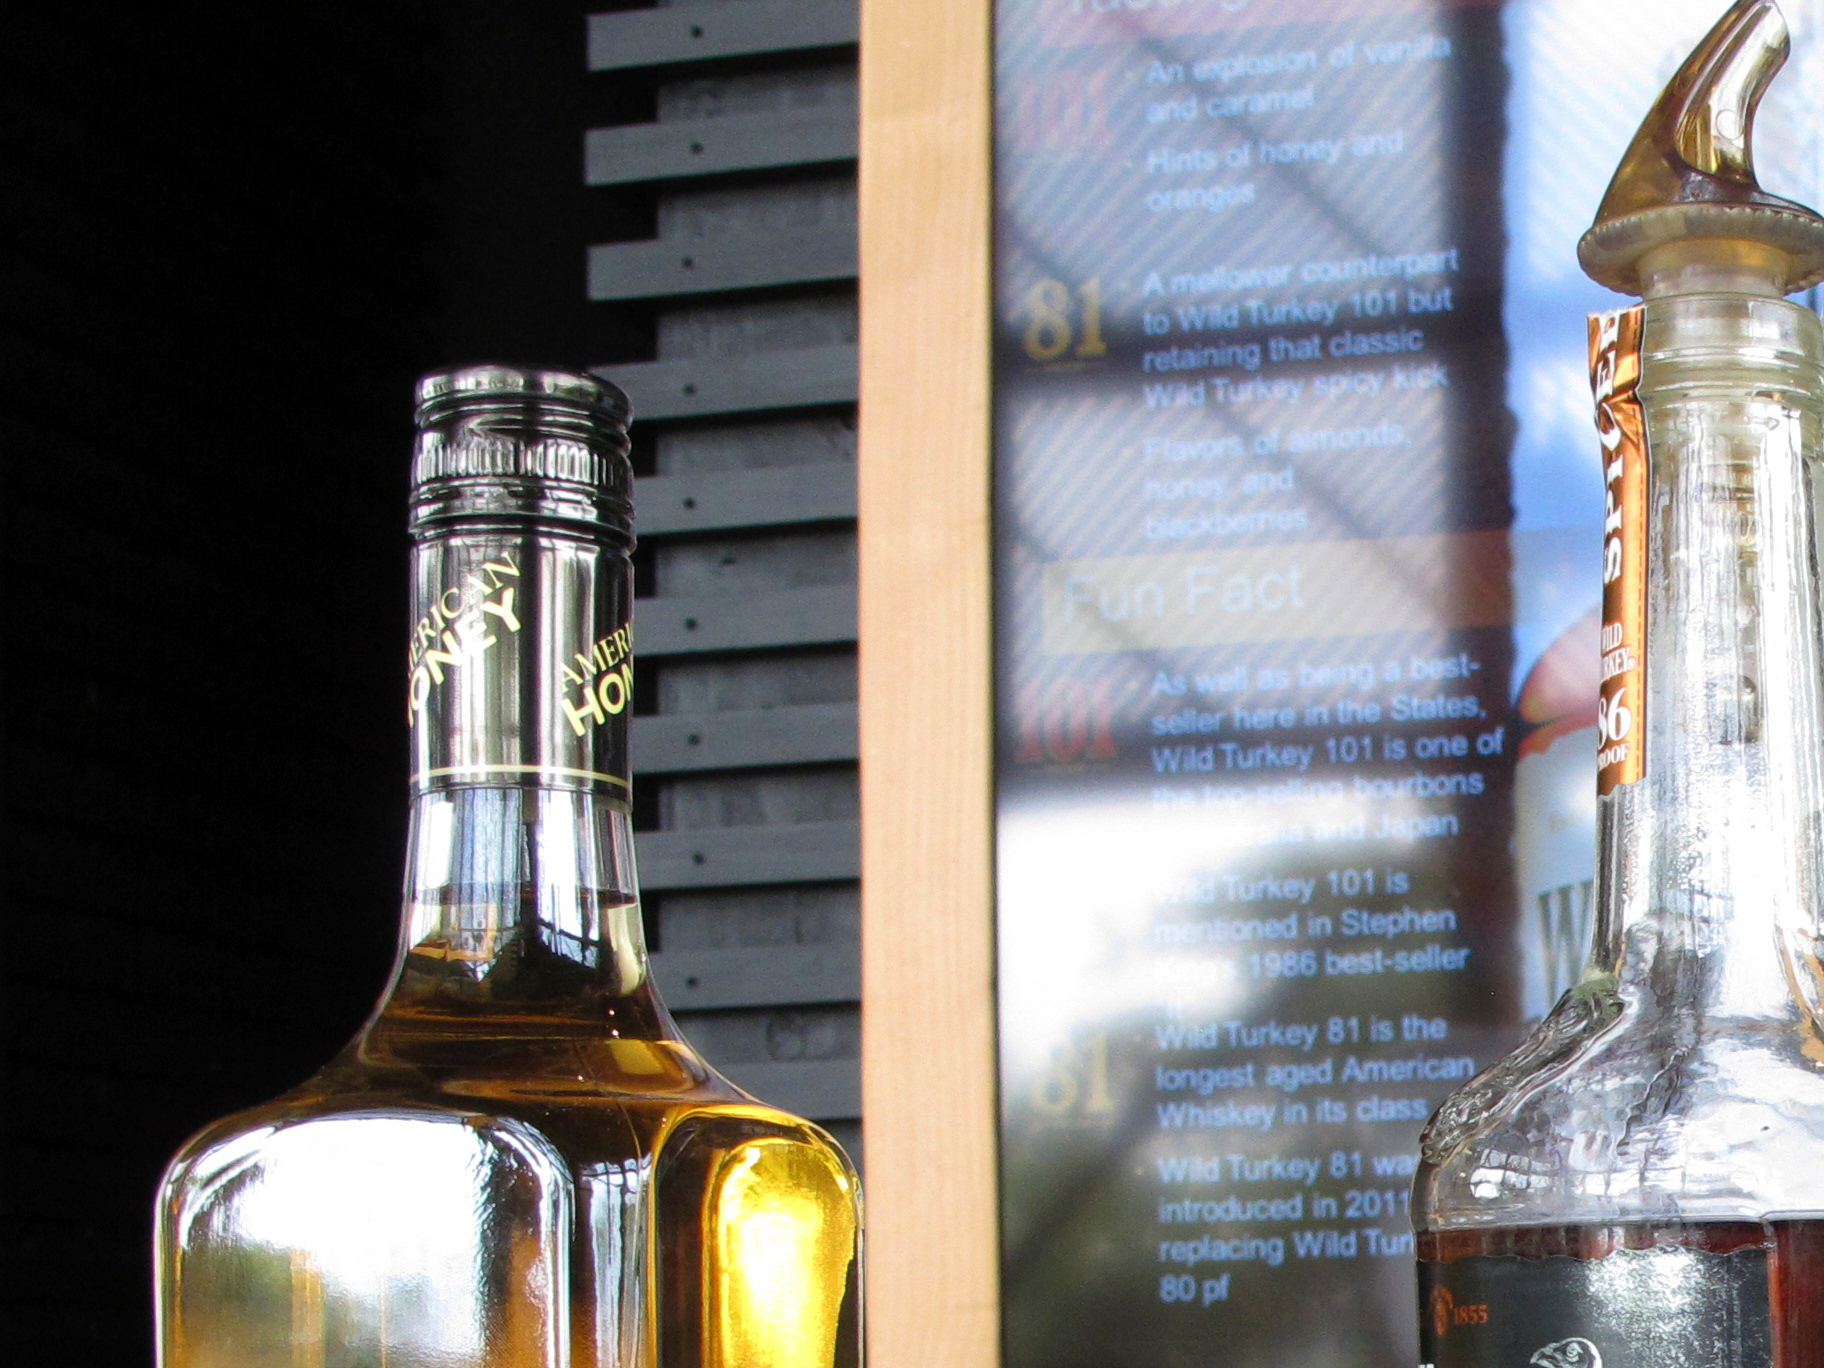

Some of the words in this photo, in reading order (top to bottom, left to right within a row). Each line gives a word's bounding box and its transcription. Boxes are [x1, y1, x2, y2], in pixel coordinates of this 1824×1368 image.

[1148, 58, 1185, 83] An
[1192, 48, 1318, 83] explosion
[1146, 90, 1197, 123] and
[1207, 84, 1315, 118] caramel
[1146, 142, 1216, 174] Hints
[1259, 135, 1343, 168] honey
[1146, 181, 1255, 213] oranges
[1170, 262, 1293, 294] mellower
[1302, 247, 1459, 287] counterpart
[1023, 273, 1108, 362] 81
[1142, 306, 1169, 336] to
[1178, 299, 1240, 334] Wild
[1248, 294, 1340, 329] Turkey
[1351, 286, 1397, 317] 101
[1407, 284, 1454, 314] but
[1142, 341, 1261, 375] retaining
[1268, 333, 1322, 362] that
[1327, 327, 1424, 357] classic
[1142, 381, 1204, 410] Wild
[1212, 374, 1306, 409] Turkey
[1312, 366, 1385, 399] spicy
[1392, 361, 1450, 391] kick
[1063, 575, 1166, 622] Fun
[1184, 564, 1307, 614] Fact
[1150, 672, 1188, 697] As
[1195, 666, 1248, 695] well
[1298, 656, 1376, 692] being
[560, 661, 634, 737] HON
[1150, 709, 1224, 737] seller
[1233, 704, 1298, 731] here
[1305, 700, 1330, 727] in
[1336, 696, 1382, 724] the
[1390, 692, 1489, 722] States,
[1150, 747, 1215, 774] Wild
[1221, 742, 1315, 772] Turkey
[1325, 736, 1374, 765] 101
[1382, 735, 1409, 761] is
[1415, 734, 1470, 759] one
[1474, 725, 1507, 757] of
[1351, 768, 1485, 797] bourbons
[1375, 812, 1460, 843] Japan
[1223, 870, 1316, 905] Turkey
[1326, 866, 1375, 896] 101
[1385, 866, 1411, 895] is
[1154, 910, 1298, 945] mentioned
[1306, 910, 1334, 938] in
[1338, 905, 1459, 940] Stephen
[1251, 950, 1319, 979] 1986
[1324, 942, 1472, 976] best-seller
[1158, 1025, 1222, 1051] Wild
[1227, 1021, 1319, 1050] Turkey
[1325, 1015, 1359, 1043] 81
[1369, 1014, 1395, 1040] is
[1402, 1013, 1449, 1040] the
[1157, 1065, 1256, 1095] longest
[1265, 1060, 1333, 1090] aged
[1341, 1053, 1476, 1082] American
[1157, 1100, 1277, 1133] Whiskey
[1283, 1097, 1309, 1124] in
[1316, 1096, 1348, 1123] its
[1355, 1094, 1428, 1122] class
[1156, 1155, 1222, 1184] Wild
[1228, 1155, 1321, 1185] Turkey
[1328, 1152, 1362, 1179] 81
[1158, 1195, 1303, 1224] introduced
[1312, 1192, 1337, 1219] in
[1343, 1190, 1410, 1218] 2011
[1158, 1235, 1285, 1266] replacing
[1292, 1230, 1357, 1257] Wild
[1158, 1274, 1196, 1302] 80
[1453, 1304, 1489, 1325] 1855
